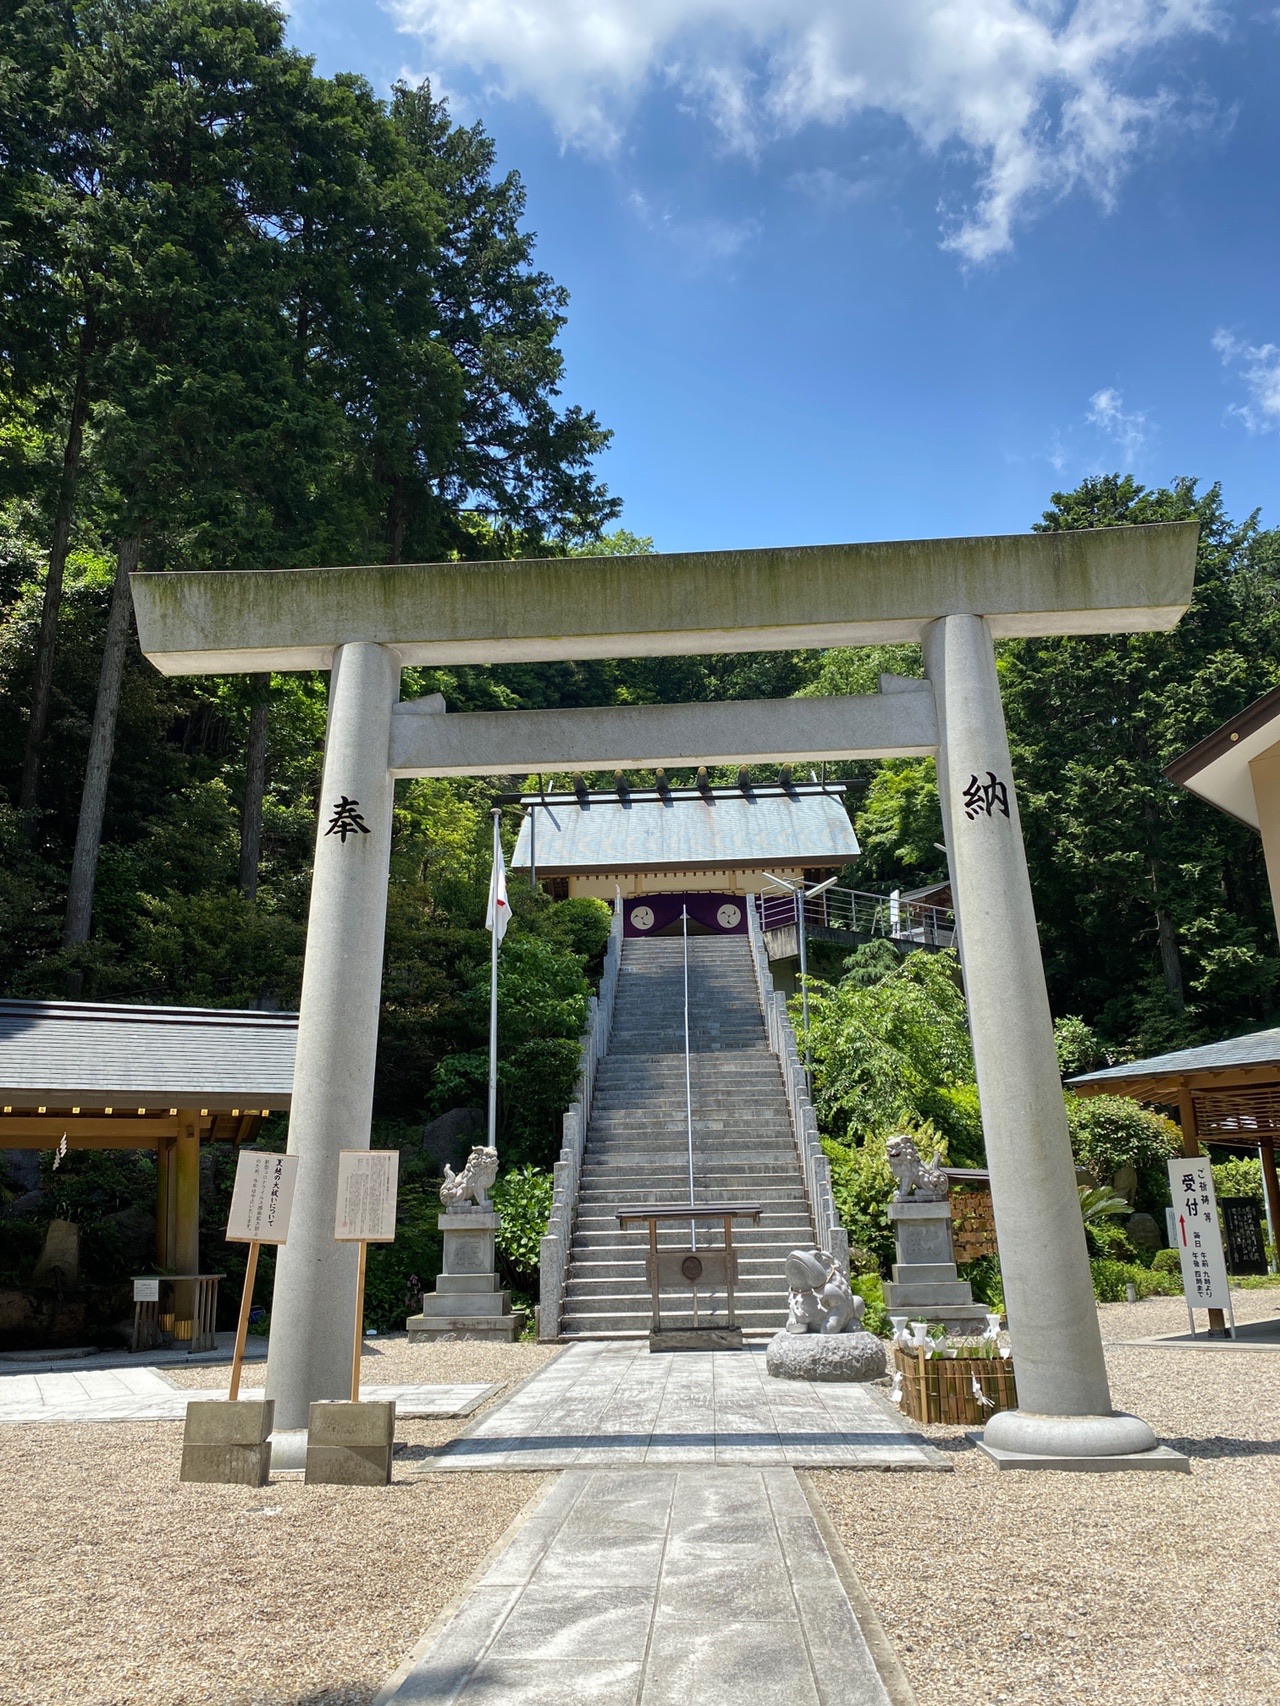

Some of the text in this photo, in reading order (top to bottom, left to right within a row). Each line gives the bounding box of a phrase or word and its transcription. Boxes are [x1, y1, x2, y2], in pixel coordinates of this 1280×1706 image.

[962, 771, 1010, 820] 納
[324, 796, 371, 843] 奉
[1182, 1173, 1199, 1217] 受付
